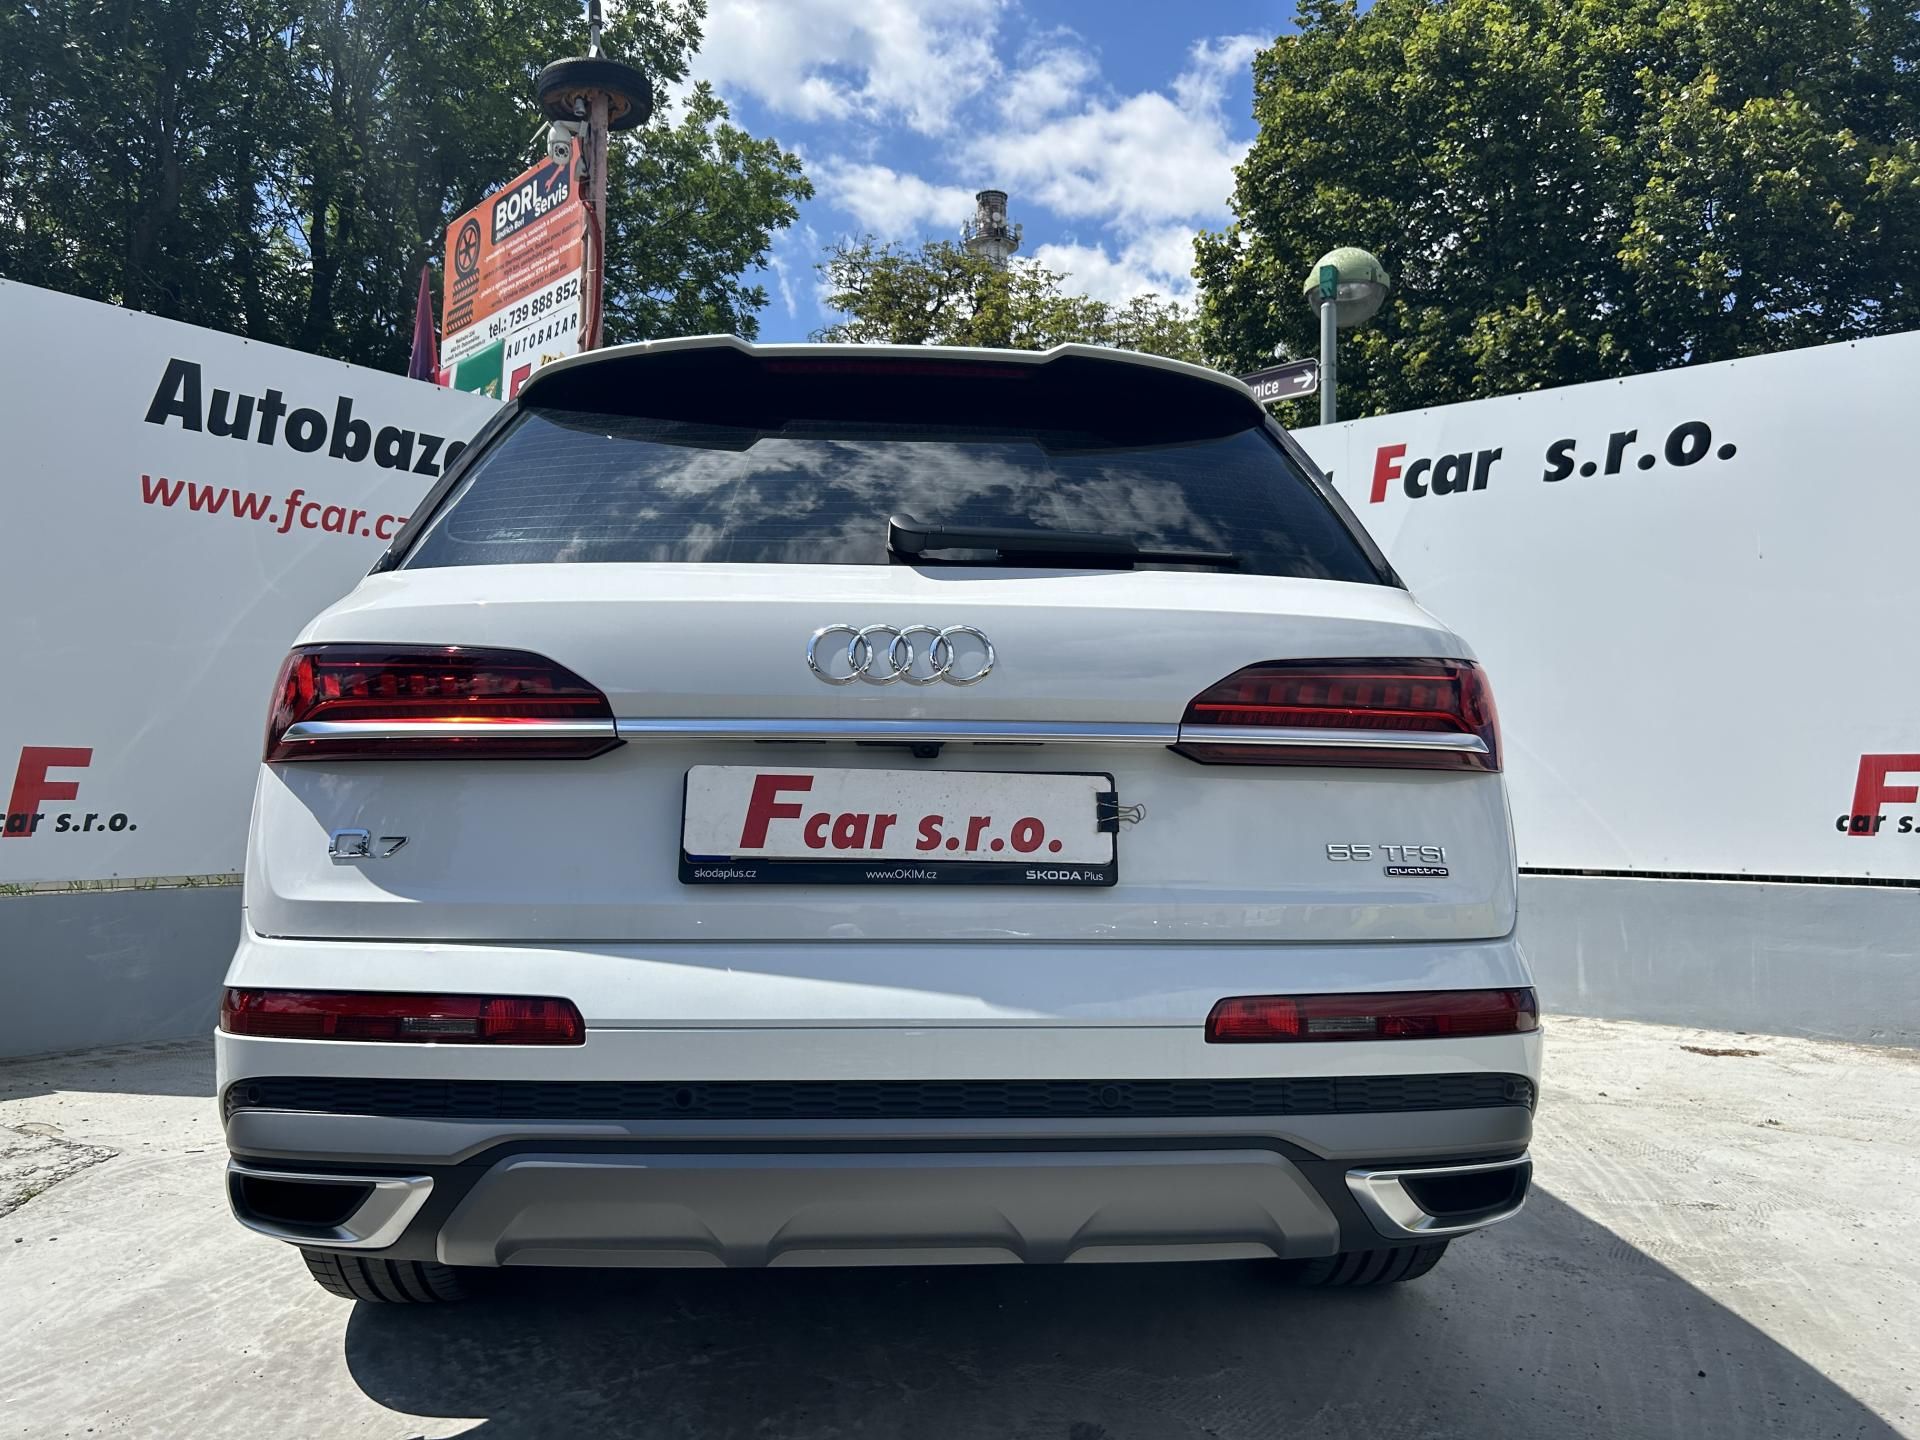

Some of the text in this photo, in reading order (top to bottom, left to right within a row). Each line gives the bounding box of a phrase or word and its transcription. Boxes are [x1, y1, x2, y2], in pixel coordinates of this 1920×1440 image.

[496, 180, 541, 230] BORL
[535, 183, 568, 217] servis
[489, 317, 507, 338] tel.:
[509, 304, 529, 328] 739
[531, 291, 553, 316] 888
[556, 278, 578, 304] 852
[506, 313, 578, 360] AUTOBAZAR
[1250, 380, 1279, 398] nice
[1370, 420, 1737, 504] Fcar s.r.o.
[55, 813, 137, 832] s.r.o.
[1836, 815, 1886, 832] car
[329, 828, 409, 859] Q7
[916, 815, 1063, 853] s.r.o.
[1326, 844, 1446, 864] 55 TFSI
[694, 868, 756, 880] skodaplus.cz
[866, 869, 937, 880] www.OKIM.cz
[1084, 871, 1104, 880] Plus
[1389, 867, 1447, 876] quattro
